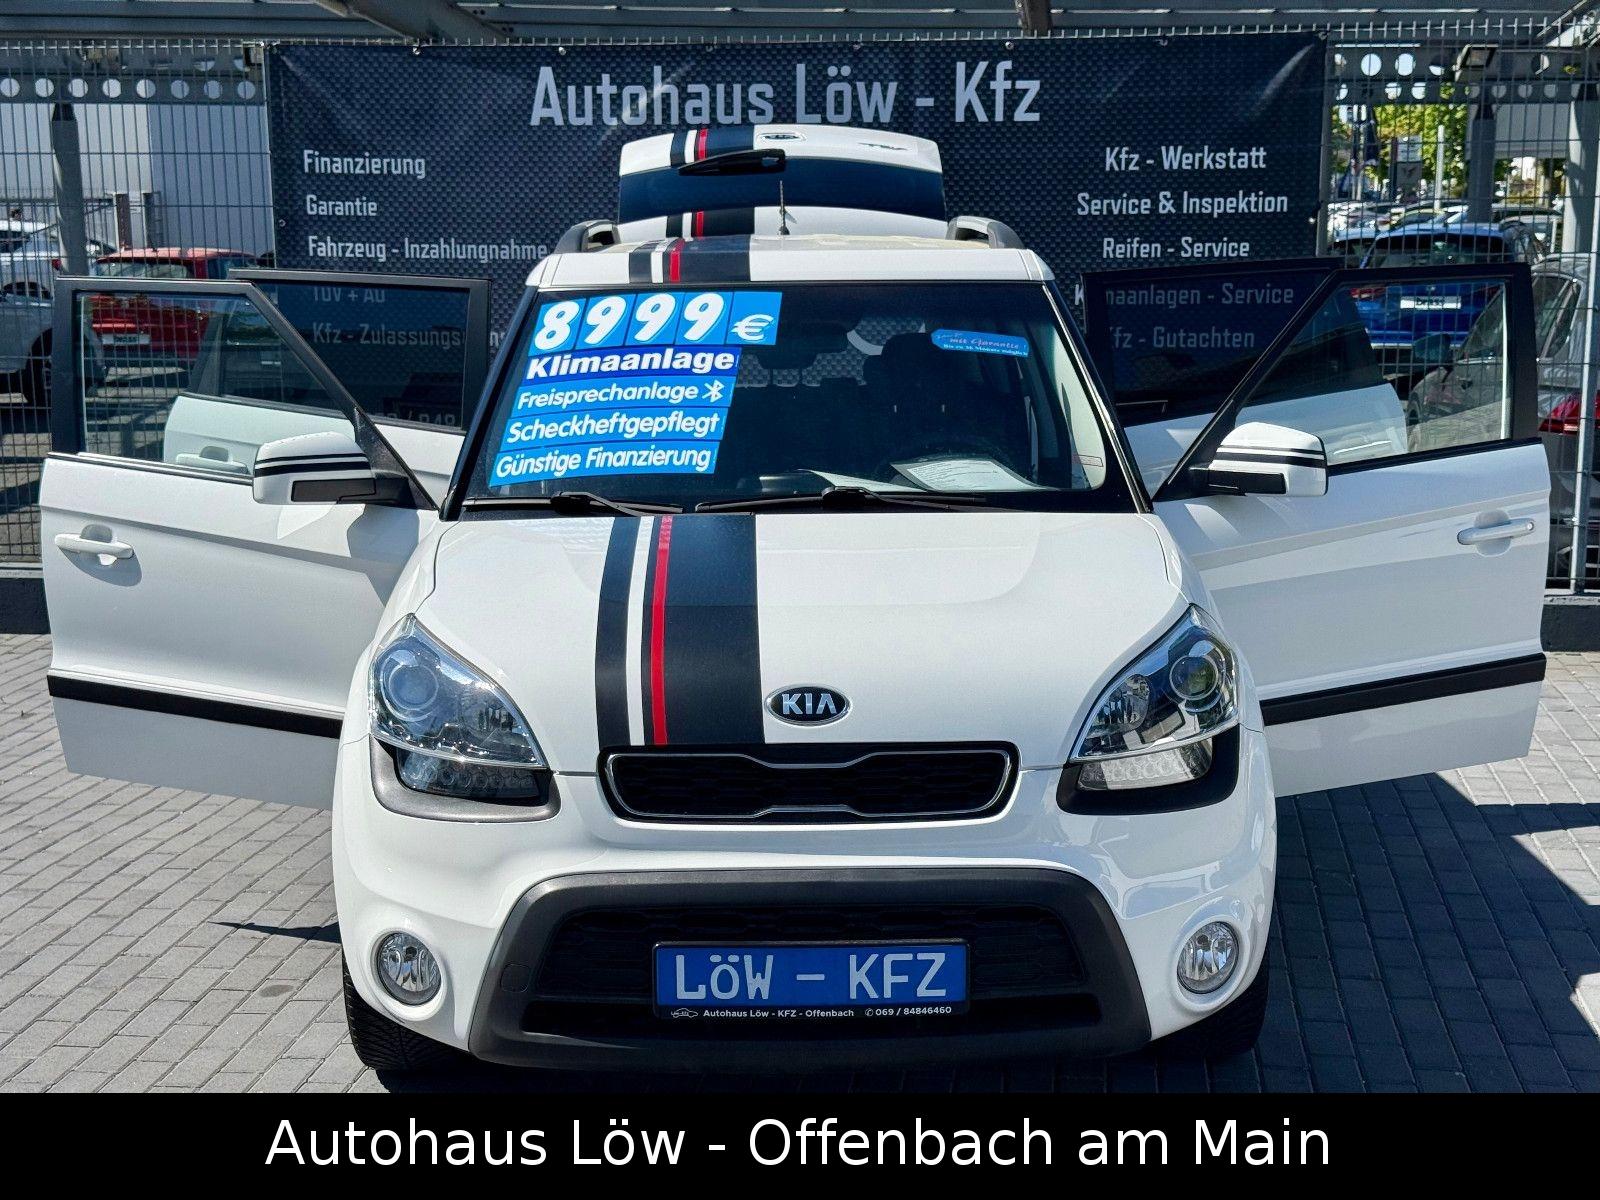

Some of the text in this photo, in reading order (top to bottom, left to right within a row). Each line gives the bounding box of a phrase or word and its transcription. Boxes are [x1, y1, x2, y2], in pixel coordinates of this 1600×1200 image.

[530, 60, 1041, 126] Autohaus Löw - Kfz
[303, 149, 426, 179] Finanzierung
[1105, 146, 1140, 171] Kfz
[1161, 145, 1267, 170] Werkstatt
[306, 194, 378, 217] Garantie
[1077, 190, 1288, 218] Service & Inspektion
[308, 235, 387, 262] Fahrzeug
[404, 237, 548, 264] Inzahlungnahme
[1102, 238, 1161, 259] Reifen
[1180, 236, 1250, 257] Service
[1221, 282, 1294, 305] Service
[312, 322, 342, 344] Kfz
[534, 293, 774, 350] 8999 €
[1109, 326, 1132, 349] fz
[1153, 326, 1255, 348] Gutachten
[526, 348, 734, 380] Klimaanlage
[517, 381, 698, 409] Freisprechanlage
[507, 411, 720, 443] Scheckheftgepflegt
[496, 445, 711, 478] Günstige Finanzierung
[781, 693, 837, 715] KIA
[796, 973, 825, 981] -
[849, 952, 947, 999] KFZ
[703, 1009, 748, 1018] Autohaus
[750, 1009, 769, 1018] Löw
[777, 1009, 797, 1018] KFZ
[805, 1009, 854, 1018] Offenbach
[875, 1008, 894, 1017] 069
[903, 1006, 952, 1016] 84846460
